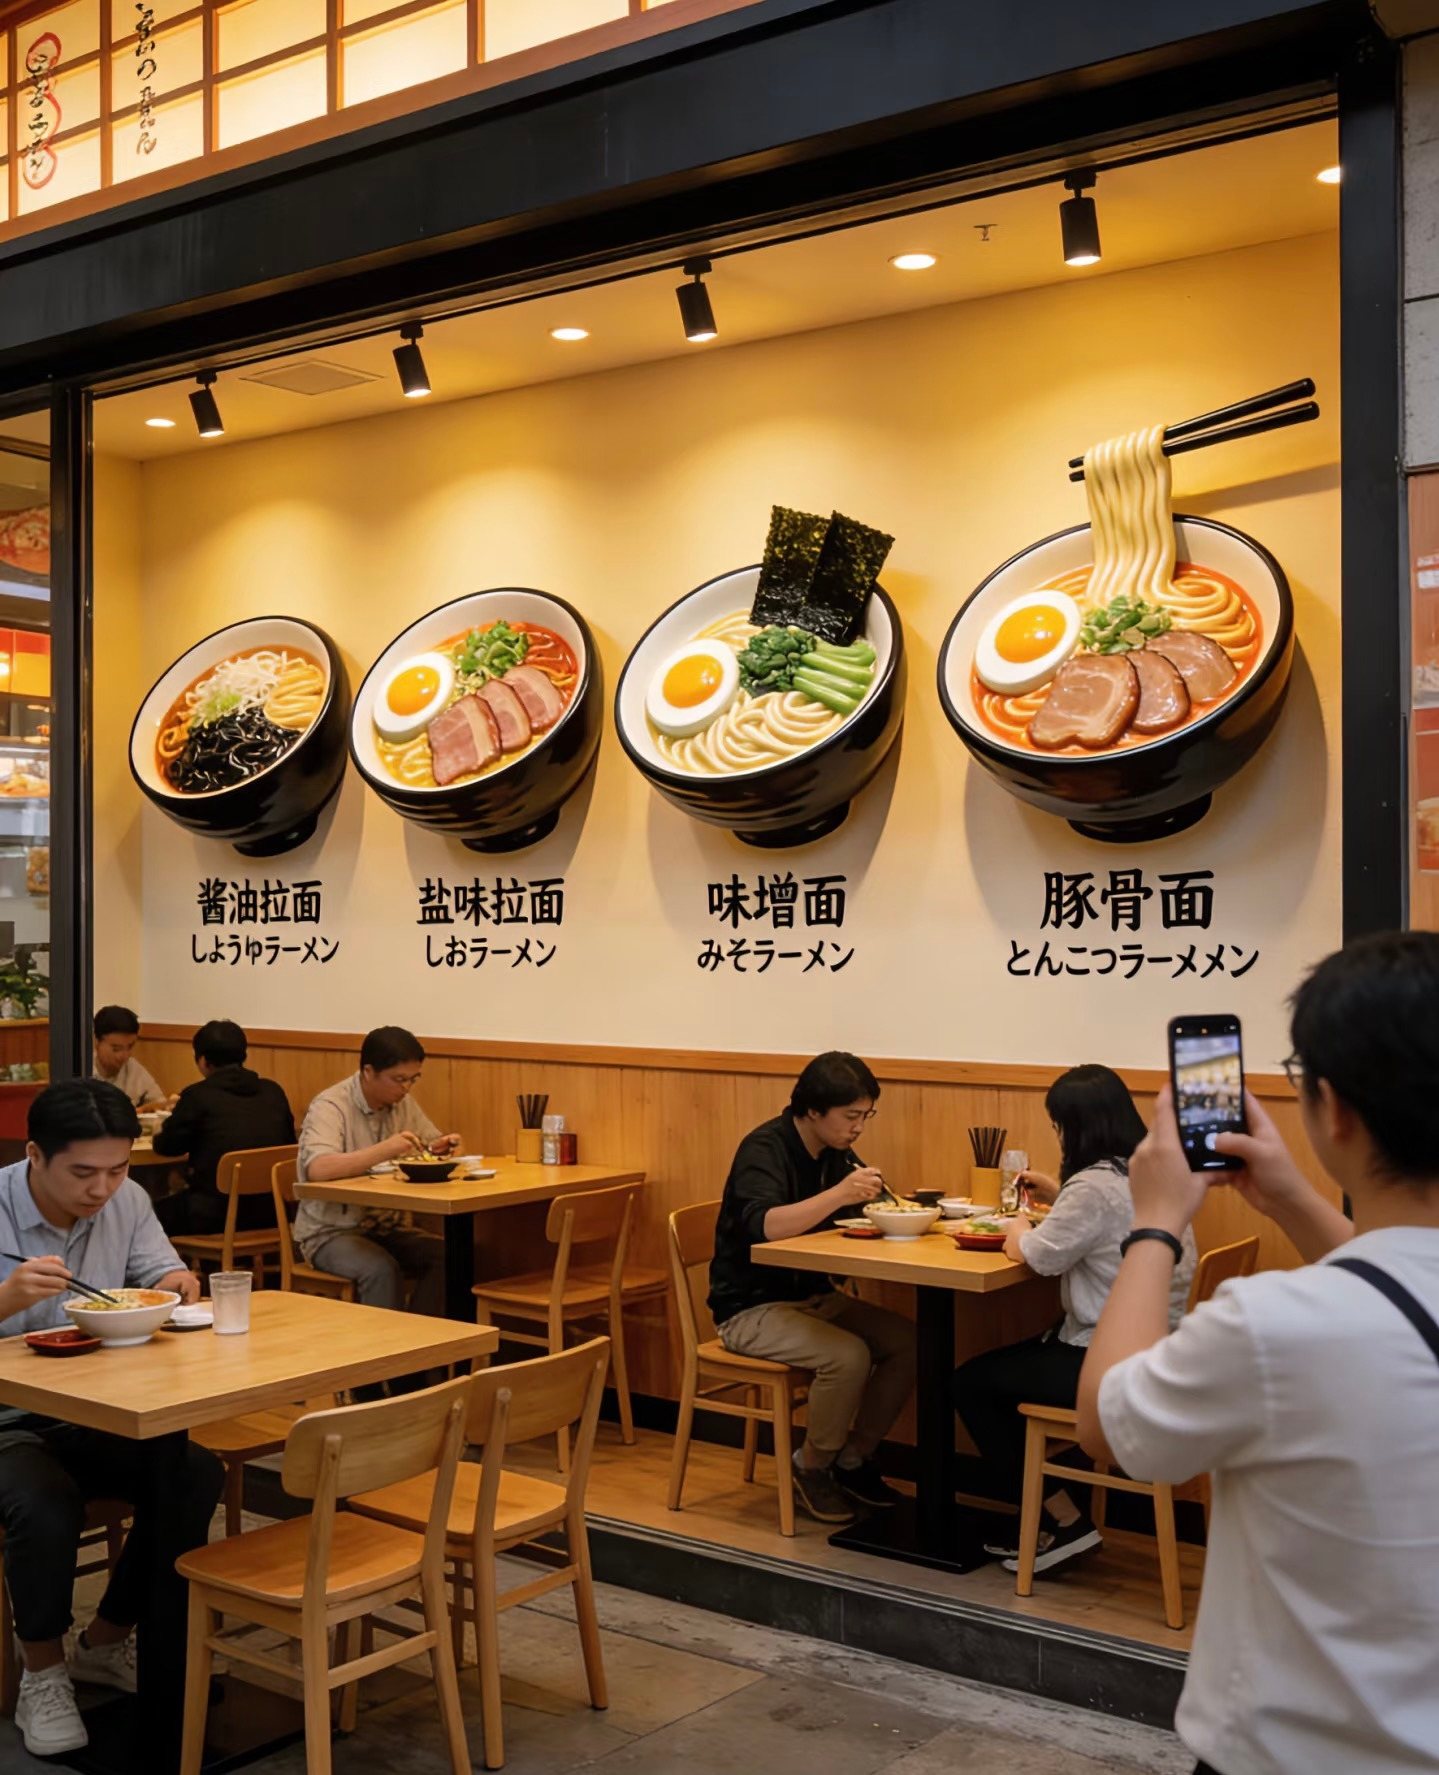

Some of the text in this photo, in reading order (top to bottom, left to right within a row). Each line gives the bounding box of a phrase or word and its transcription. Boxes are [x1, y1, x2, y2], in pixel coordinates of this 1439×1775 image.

[416, 877, 565, 927] 盐味拉面
[707, 871, 847, 929] 味增面
[1040, 868, 1215, 932] 豚骨面
[426, 934, 557, 969] しおラーメン
[697, 938, 855, 973] みそラーメン
[1007, 940, 1260, 979] とんこつラーメメン
